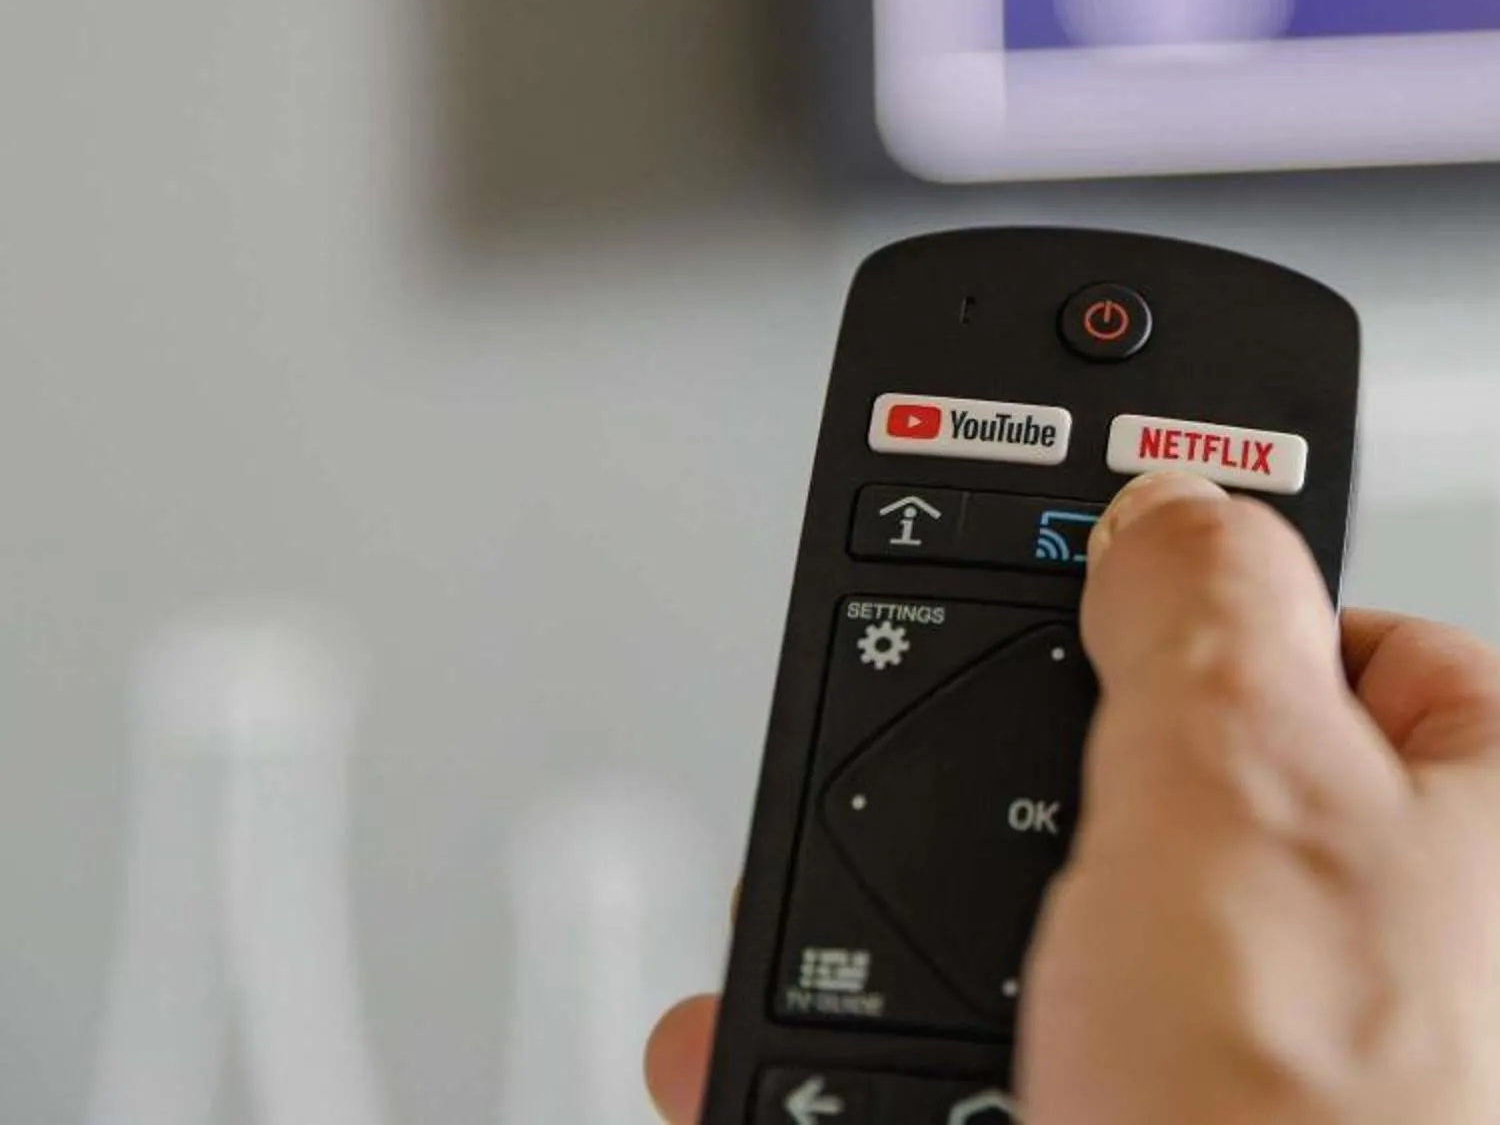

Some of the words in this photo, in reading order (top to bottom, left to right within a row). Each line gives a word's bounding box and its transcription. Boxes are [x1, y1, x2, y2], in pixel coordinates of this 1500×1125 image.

[950, 409, 1057, 448] YouTube
[1139, 426, 1275, 475] NETFLIX
[847, 602, 946, 625] SETTINGS
[1007, 797, 1060, 834] OK
